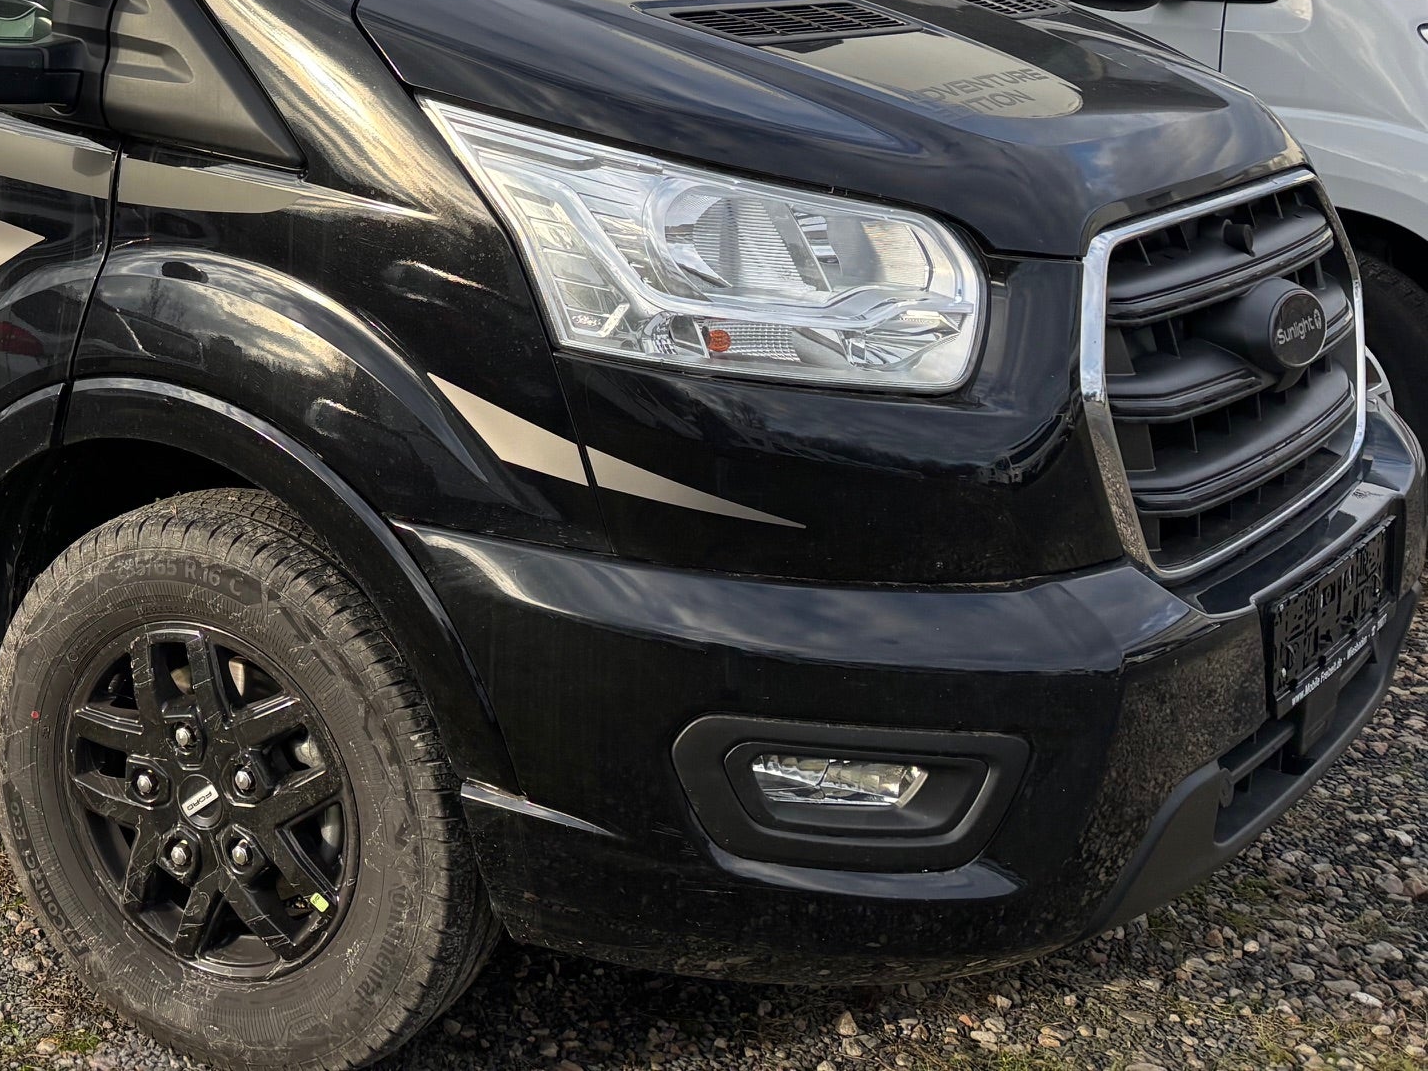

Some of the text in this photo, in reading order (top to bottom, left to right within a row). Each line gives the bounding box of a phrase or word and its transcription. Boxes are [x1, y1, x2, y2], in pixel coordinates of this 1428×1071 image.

[905, 68, 1050, 102] ADVENTURE
[1276, 316, 1315, 345] Sunlight
[186, 790, 213, 811] FORD
